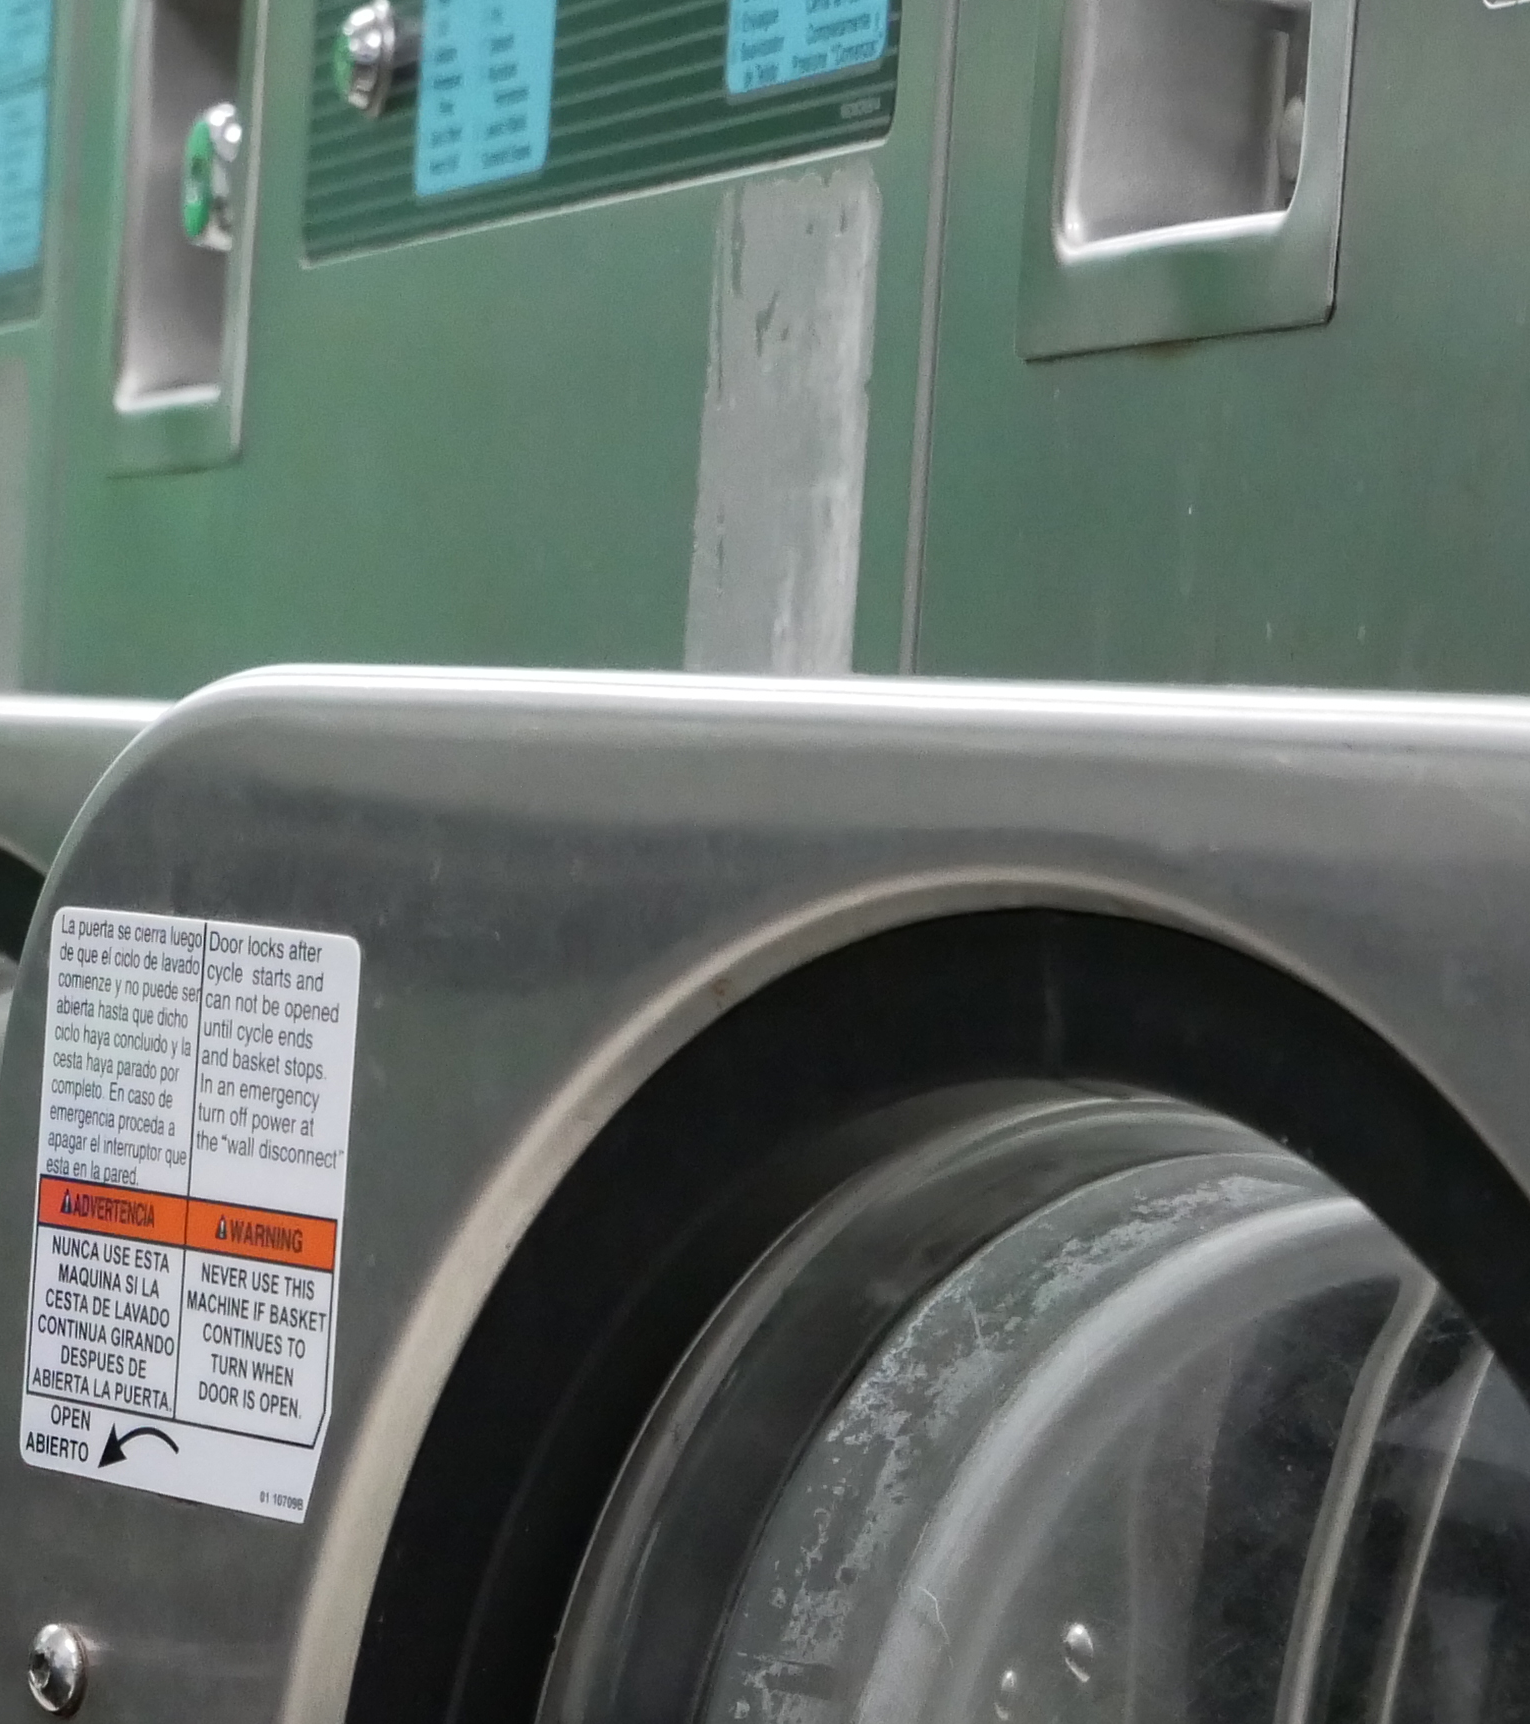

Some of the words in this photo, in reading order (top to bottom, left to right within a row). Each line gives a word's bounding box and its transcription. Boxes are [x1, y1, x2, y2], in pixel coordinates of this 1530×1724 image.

[62, 914, 75, 934] La
[79, 920, 114, 940] puerta
[118, 925, 131, 940] se
[135, 927, 166, 944] cierra
[170, 926, 202, 952] luego
[210, 931, 243, 953] Door
[248, 936, 284, 959] locks
[289, 940, 322, 963] after
[60, 943, 73, 961] de
[78, 949, 97, 967] que
[102, 947, 112, 965] el
[115, 949, 140, 969] ciclo
[144, 951, 157, 970] de
[161, 953, 199, 975] lavado
[58, 972, 111, 992] comienze
[115, 979, 122, 998] y
[125, 982, 139, 995] no
[143, 981, 178, 1001] puede
[182, 988, 202, 1003] ser
[207, 962, 243, 985] cycle
[252, 967, 291, 988] starts
[296, 972, 324, 992] and
[57, 996, 94, 1017] abierta
[98, 1000, 128, 1021] hasta
[133, 1009, 153, 1027] que
[157, 1007, 188, 1029] dicho
[206, 992, 230, 1009] can
[235, 995, 257, 1013] not
[263, 995, 279, 1016] be
[285, 1002, 339, 1023] opened
[55, 1023, 80, 1042] ciclo
[83, 1028, 111, 1048] haya
[114, 1031, 168, 1055] concluido
[171, 1039, 178, 1059] y
[182, 1036, 191, 1057] la
[204, 1019, 233, 1038] until
[237, 1023, 273, 1047] cycle
[279, 1028, 313, 1049] ends
[53, 1051, 83, 1070] cesta
[86, 1053, 113, 1078] haya
[117, 1060, 156, 1079] parado
[160, 1066, 179, 1084] por
[202, 1048, 228, 1067] and
[233, 1049, 280, 1074] basket
[285, 1057, 326, 1084] stops.
[110, 1082, 124, 1102] En
[128, 1088, 155, 1106] caso
[159, 1090, 173, 1109] de
[200, 1073, 212, 1093] In
[218, 1080, 234, 1096] an
[240, 1082, 320, 1113] emergency
[50, 1105, 114, 1129] emergencia
[119, 1114, 164, 1135] proceda
[168, 1121, 175, 1136] a
[199, 1103, 225, 1124] turn
[230, 1107, 247, 1127] off
[252, 1113, 296, 1134] power
[301, 1118, 314, 1137] at
[48, 1131, 87, 1154] apagar
[91, 1135, 100, 1152] el
[104, 1138, 162, 1163] interruptor
[165, 1148, 187, 1168] que
[197, 1130, 218, 1152] the
[73, 1162, 87, 1177] en
[91, 1160, 100, 1180] la
[104, 1164, 138, 1186] pared.
[75, 1194, 155, 1228] ADVERTENCIA
[231, 1219, 303, 1253] WARNING
[52, 1235, 100, 1261] NUNCA
[104, 1243, 131, 1266] USE
[135, 1250, 169, 1273] ESTA
[59, 1264, 121, 1292] MAQUINA
[126, 1275, 138, 1295] SI
[142, 1278, 159, 1299] LA
[202, 1262, 247, 1289] NEVER
[252, 1271, 279, 1294] USE
[284, 1276, 315, 1300] THIS
[46, 1288, 88, 1314] CESTA
[93, 1296, 111, 1317] DE
[115, 1300, 169, 1328] LAVADO
[187, 1290, 249, 1319] MACHINE
[254, 1301, 266, 1321] IF
[270, 1304, 326, 1331] BASKET
[38, 1314, 107, 1344] CONTINUA
[111, 1327, 174, 1356] GIRANDO
[203, 1323, 282, 1355] CONTINUES
[288, 1337, 305, 1359] TO
[61, 1345, 124, 1374] DESPUES
[129, 1358, 146, 1379] DE
[211, 1354, 248, 1379] TURN
[252, 1361, 294, 1387] WHEN
[33, 1368, 90, 1396] ABIERTA
[94, 1379, 111, 1400] LA
[115, 1382, 172, 1412] PUERTA.
[199, 1381, 239, 1406] DOOR
[243, 1389, 255, 1410] IS
[260, 1393, 302, 1419] OPEN.
[51, 1404, 91, 1431] OPEN
[26, 1431, 89, 1462] ABIERTO
